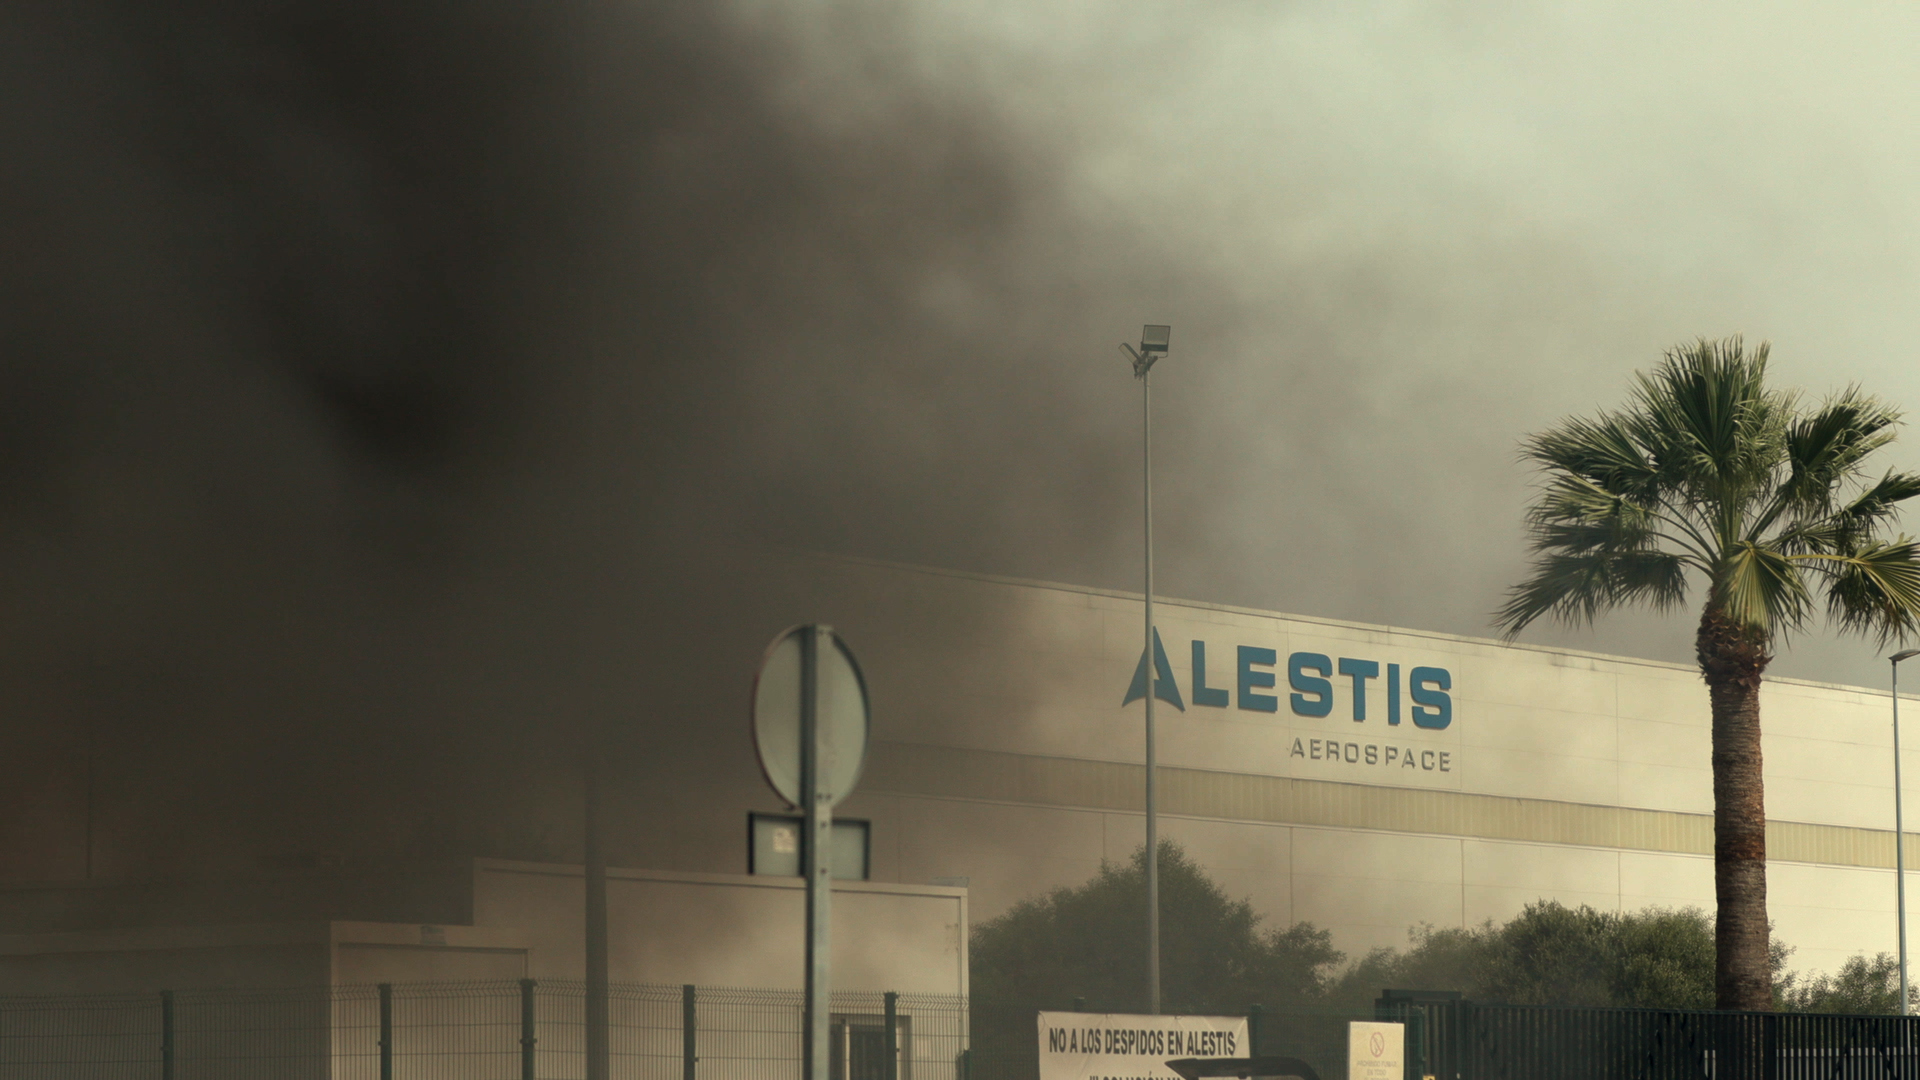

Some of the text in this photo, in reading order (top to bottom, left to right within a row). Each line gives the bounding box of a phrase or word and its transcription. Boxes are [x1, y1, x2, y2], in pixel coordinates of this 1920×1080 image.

[1122, 626, 1452, 730] ALESTIS
[1290, 738, 1451, 772] AEROSPACE
[1049, 1028, 1236, 1056] NO A LOS DESPIDOS EN ALESTIS
